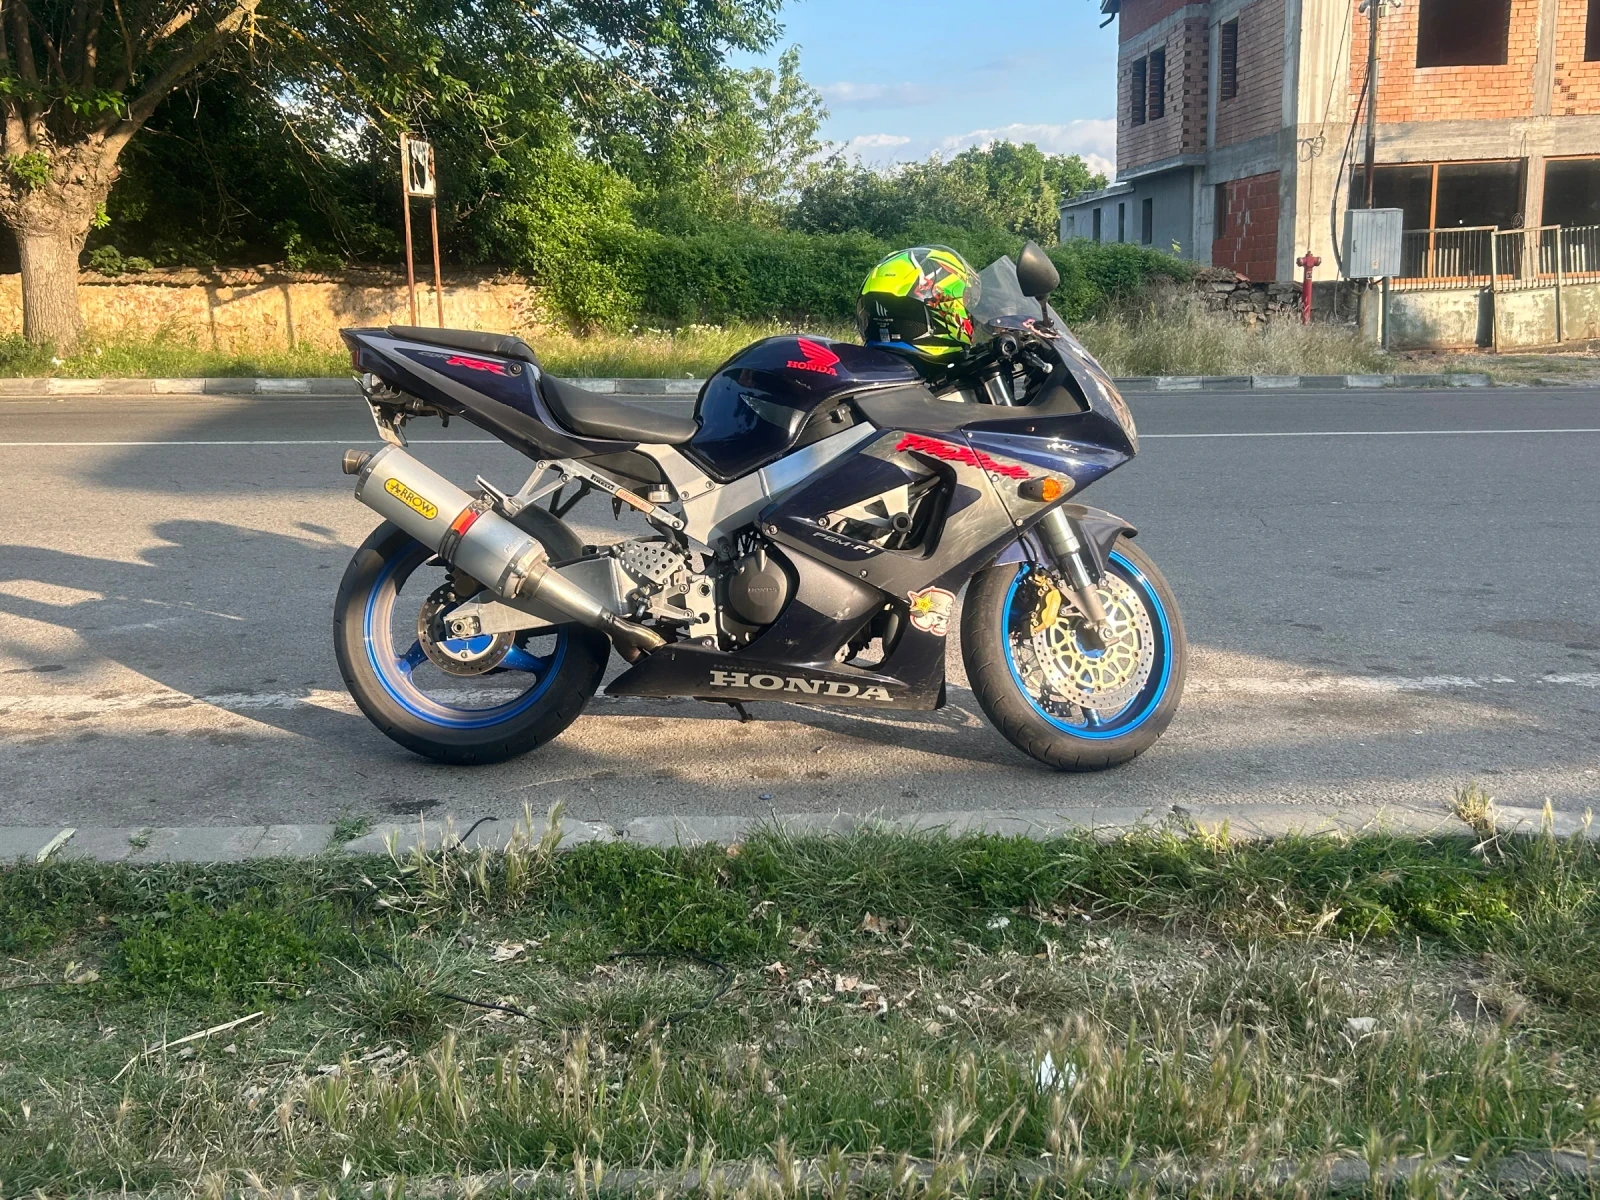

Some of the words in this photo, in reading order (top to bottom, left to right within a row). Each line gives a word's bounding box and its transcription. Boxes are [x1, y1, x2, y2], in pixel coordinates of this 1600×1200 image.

[786, 360, 838, 376] HONDA
[390, 483, 434, 513] ARROW
[709, 670, 894, 702] HONDA
